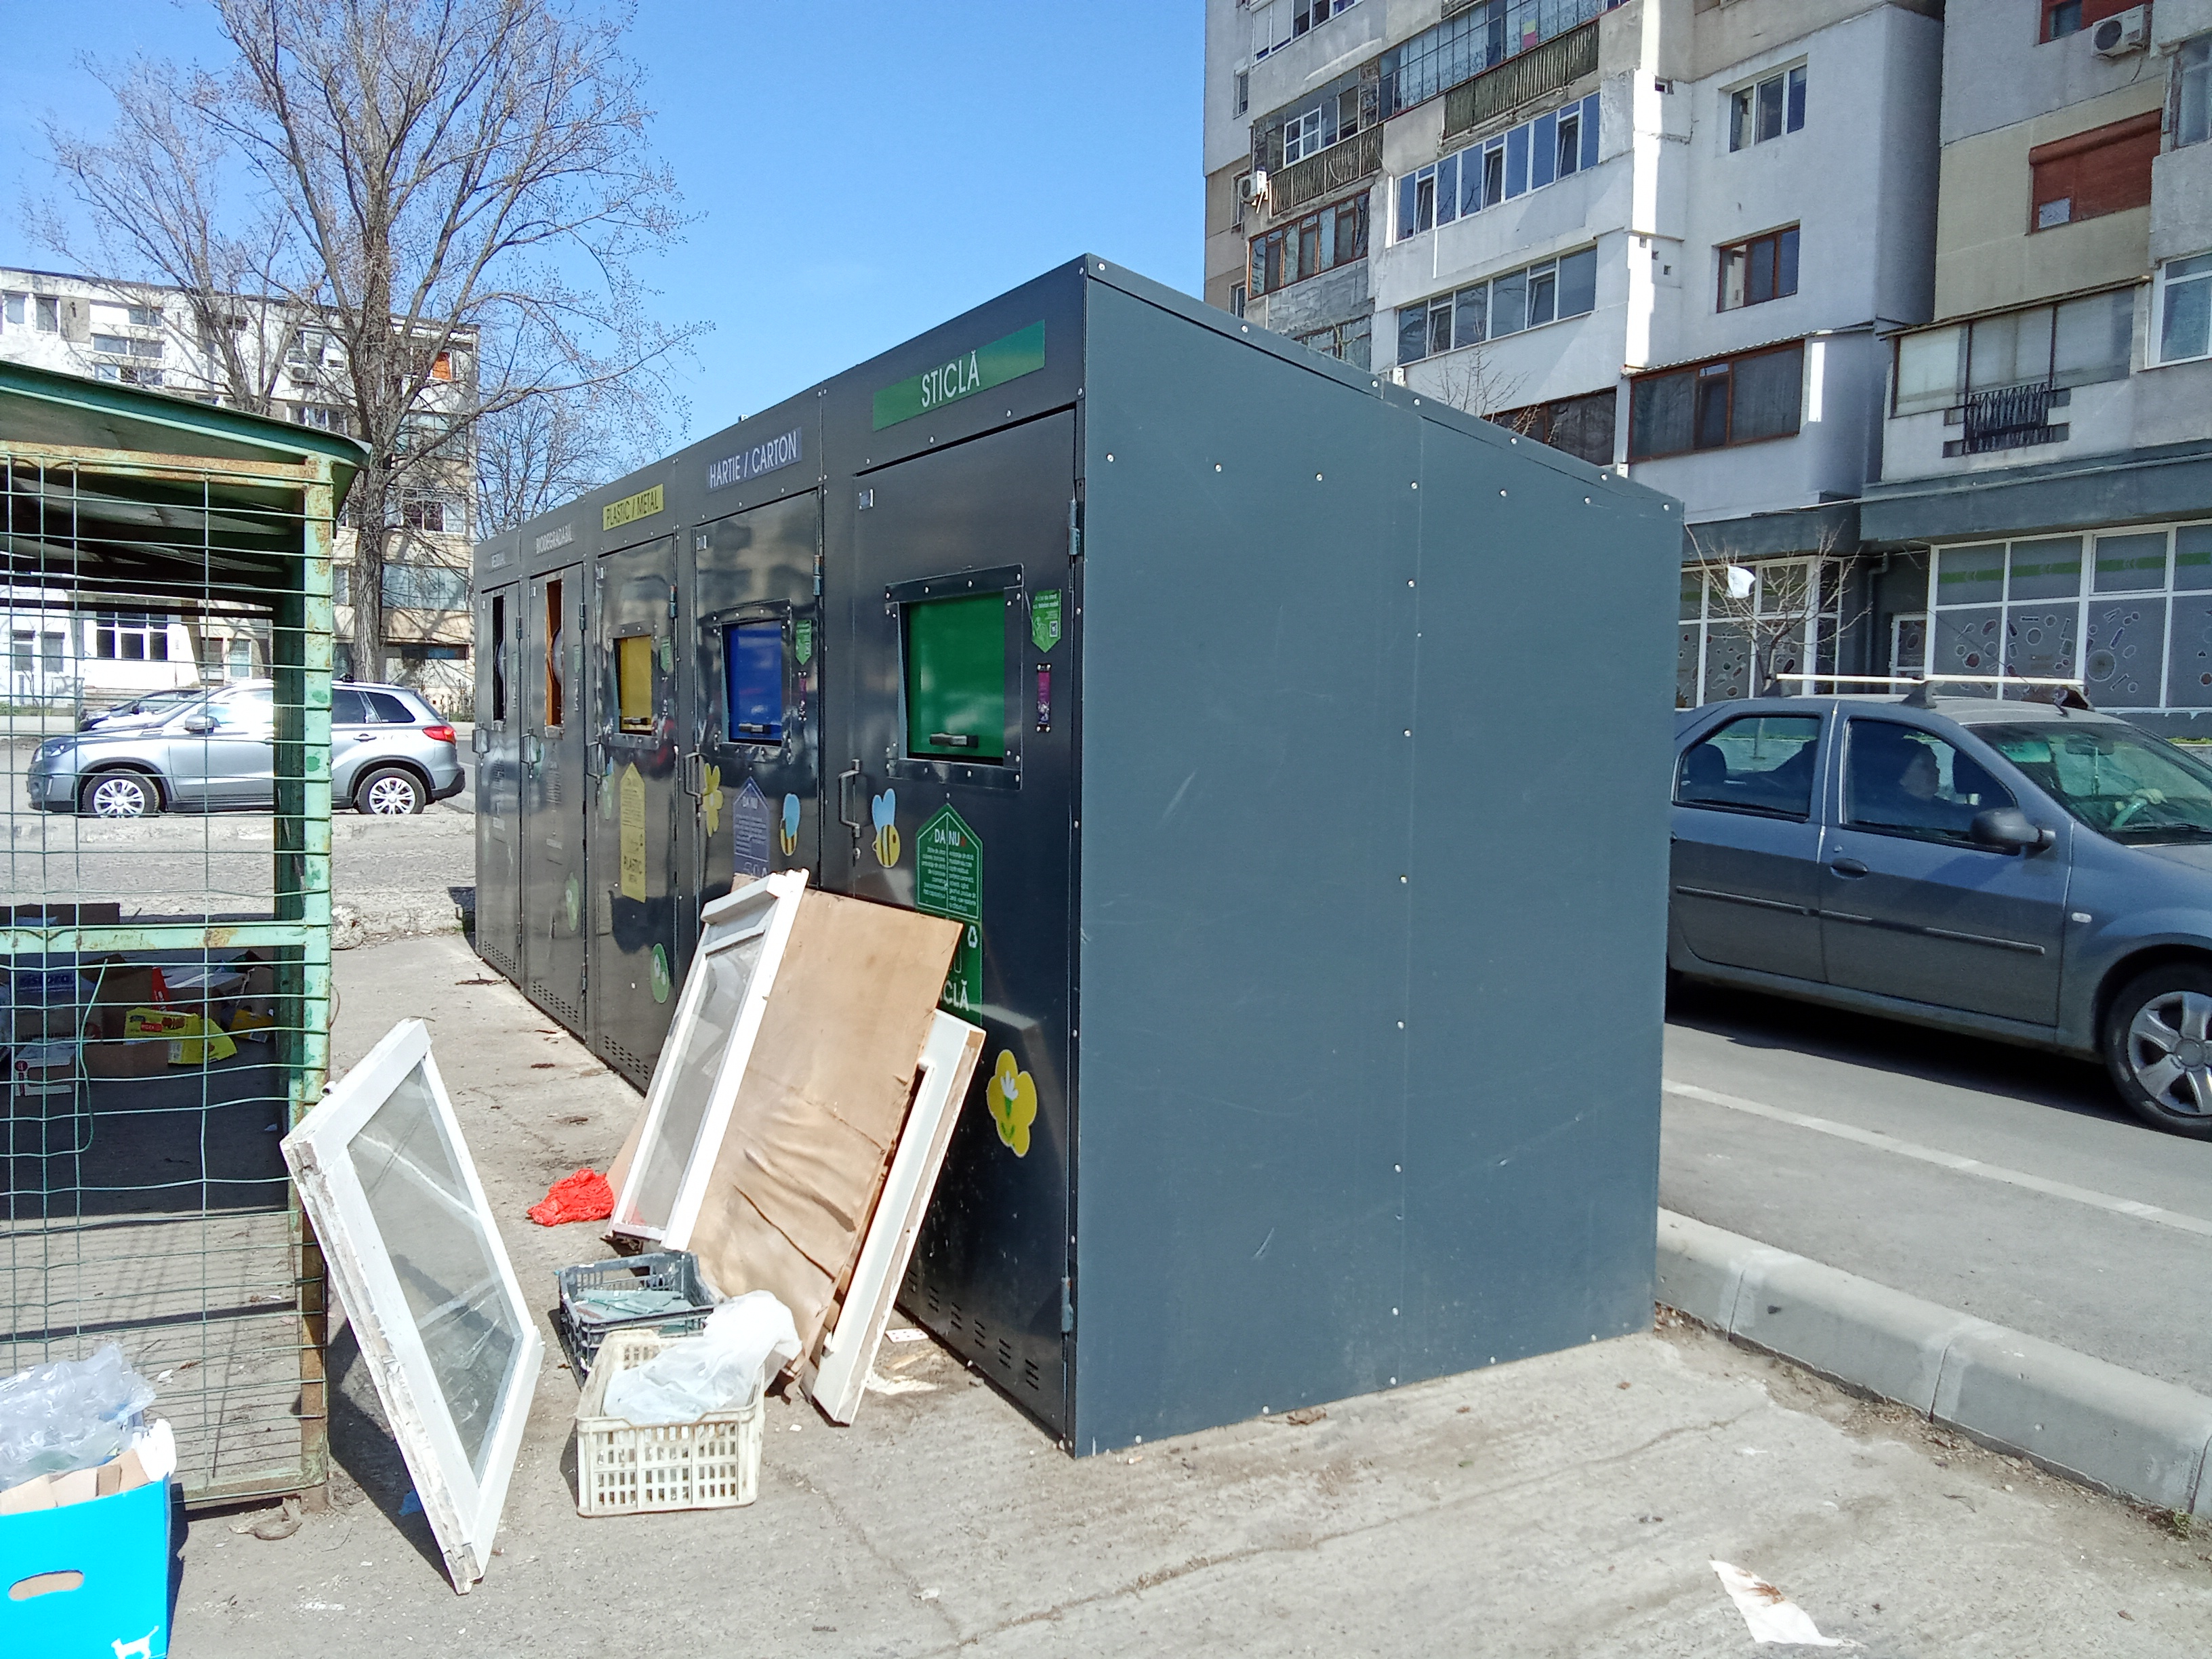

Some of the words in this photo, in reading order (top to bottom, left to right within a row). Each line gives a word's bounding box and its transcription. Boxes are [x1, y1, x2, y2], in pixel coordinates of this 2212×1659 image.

[921, 349, 980, 408] STICLĂ
[752, 430, 797, 474] CARTON
[607, 500, 630, 527] PLASTIC
[637, 490, 659, 515] METAL
[935, 828, 946, 844] DA
[948, 830, 960, 846] NU
